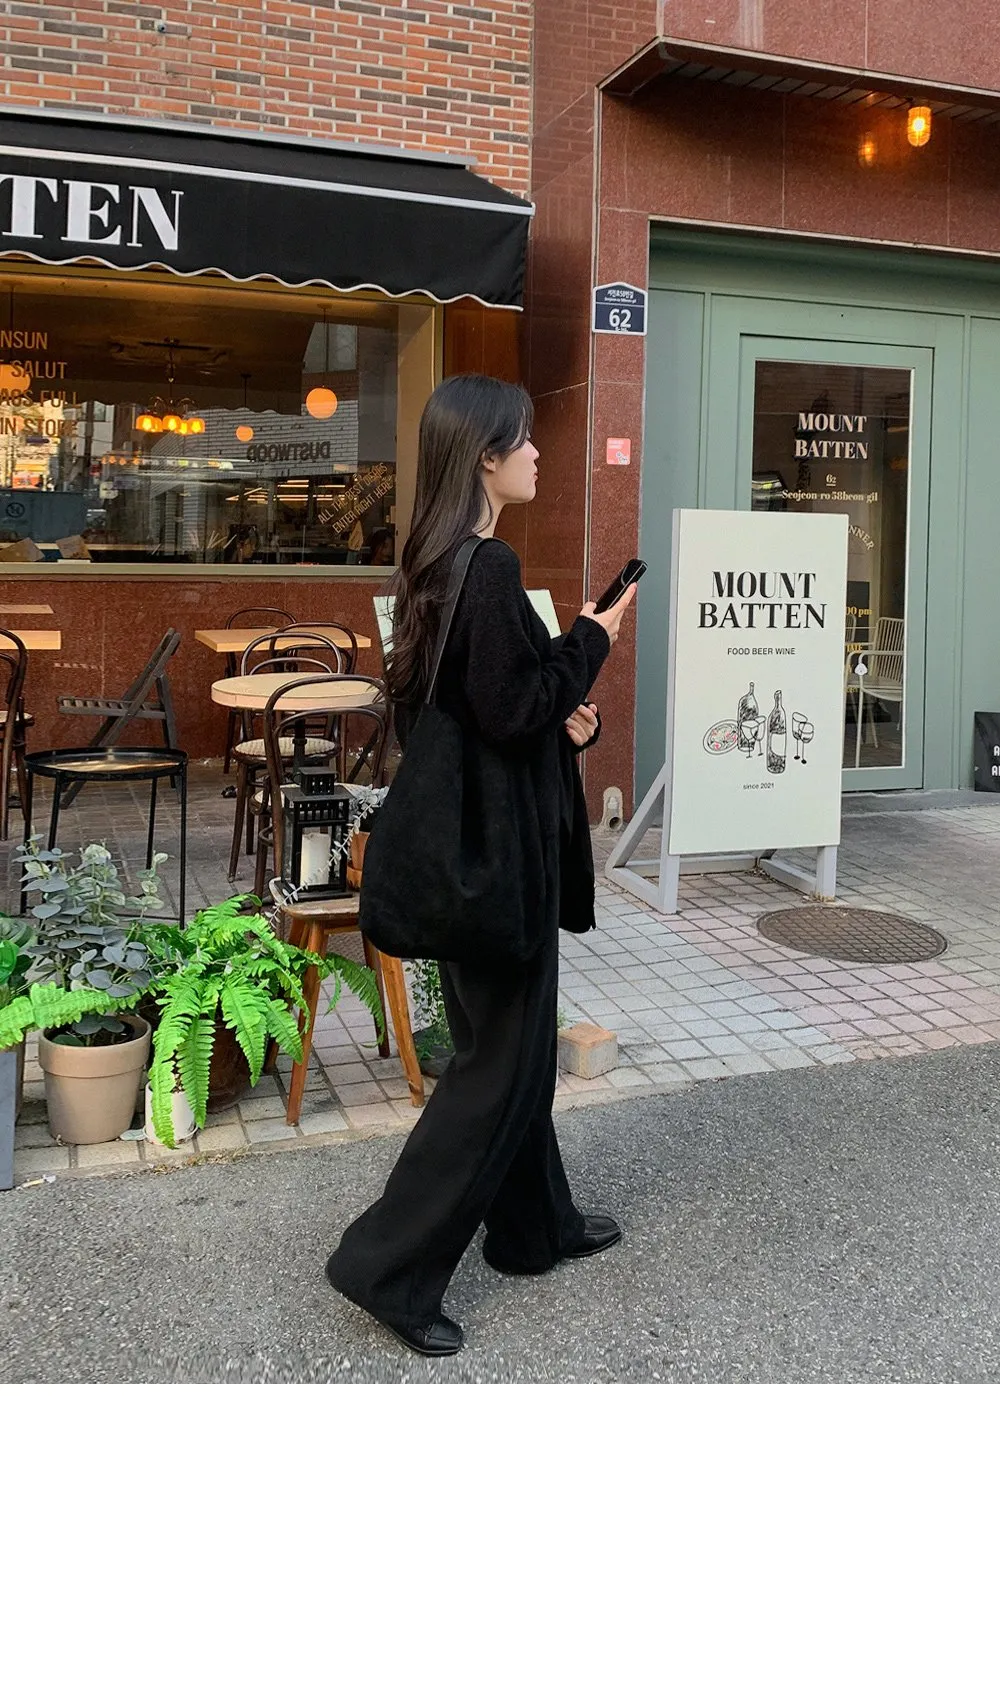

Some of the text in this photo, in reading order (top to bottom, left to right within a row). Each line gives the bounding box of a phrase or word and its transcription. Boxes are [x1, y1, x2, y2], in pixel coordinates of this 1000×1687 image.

[0, 173, 184, 251] TEN
[609, 308, 631, 328] 62
[11, 359, 67, 379] SALUT
[798, 412, 867, 432] MOUNT
[794, 439, 868, 459] BATTEN
[317, 508, 335, 525] ALL
[331, 495, 349, 512] THE
[345, 480, 365, 501] BEST
[332, 480, 394, 534] ENTER RIGHT HERE
[711, 571, 816, 598] MOUNT
[697, 602, 827, 628] BATTEN
[727, 647, 796, 655] FOOD BEER WINE
[760, 782, 775, 790] 2021
